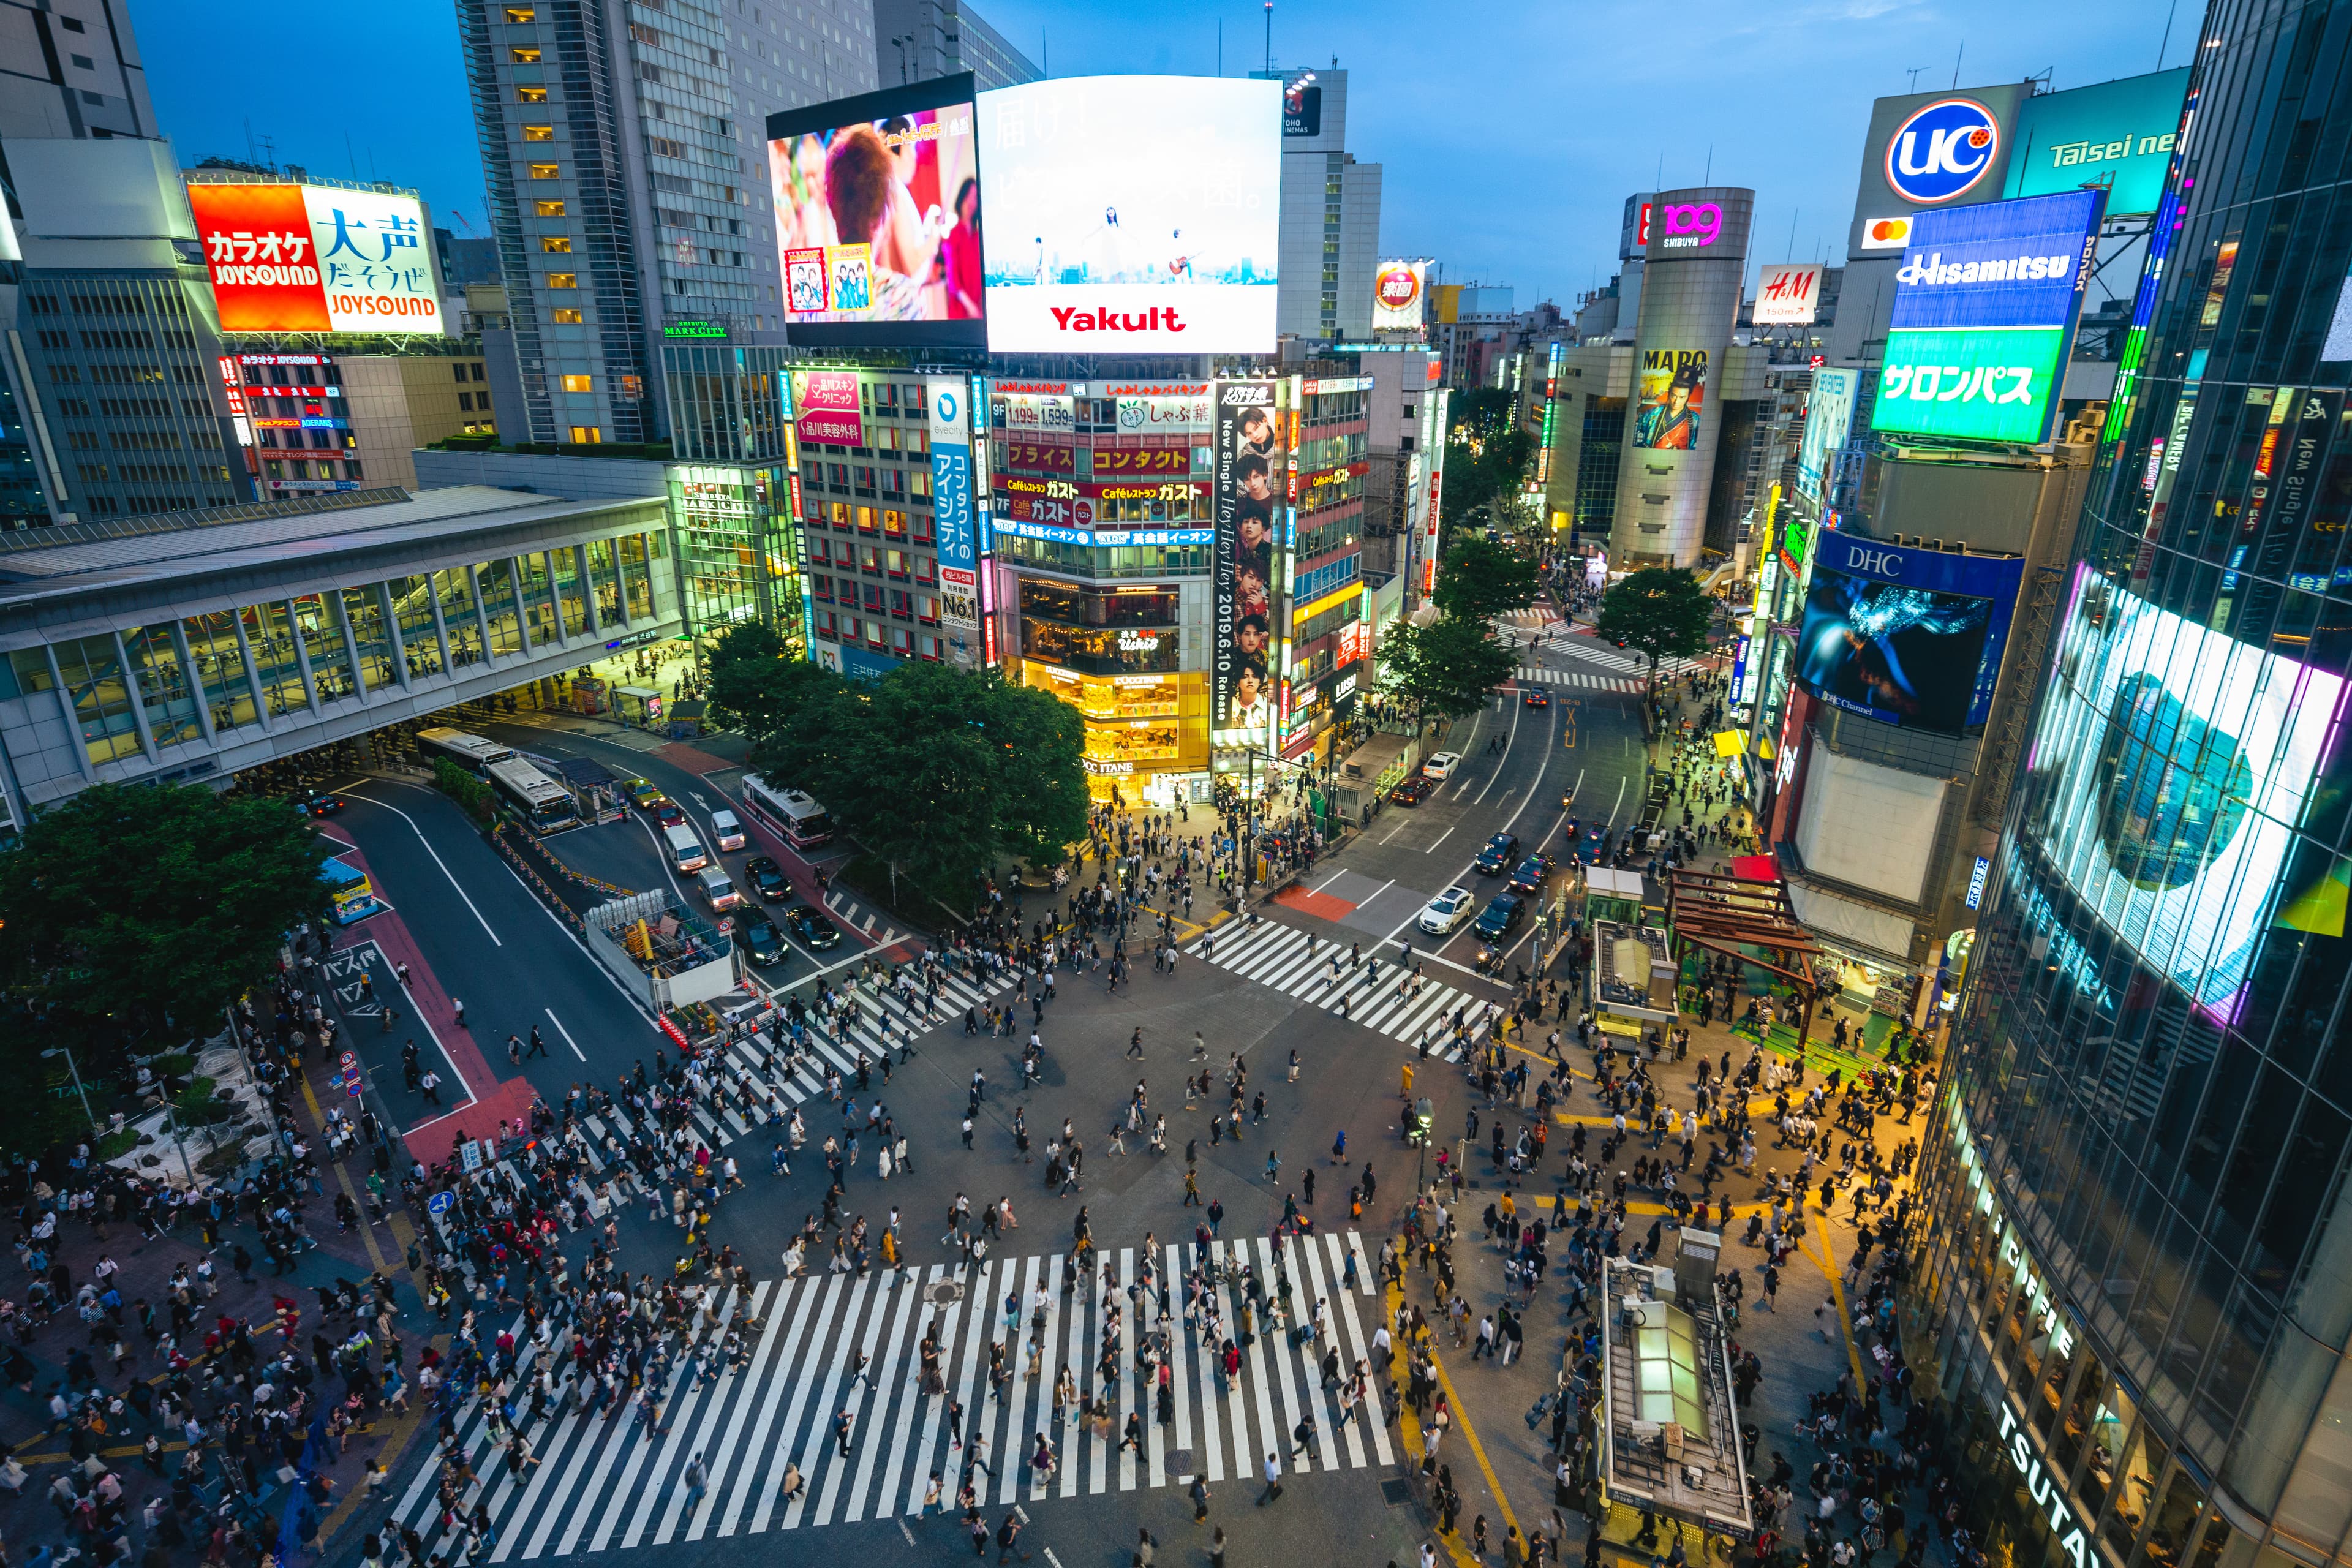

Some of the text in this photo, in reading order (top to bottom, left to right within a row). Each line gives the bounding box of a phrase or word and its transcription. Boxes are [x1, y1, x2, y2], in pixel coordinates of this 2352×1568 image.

[2050, 134, 2132, 168] Taisei
[317, 208, 419, 262] 大声
[1664, 203, 1722, 246] 109
[207, 231, 309, 263] カラオケ
[1664, 237, 1698, 247] SHIBUYA
[1896, 252, 2070, 286] Hisamitsu
[2073, 235, 2095, 292] サロンパス
[216, 264, 318, 285] JOYSOUND
[324, 262, 433, 295] だそうぜ。
[1382, 281, 1412, 297] 楽園
[1764, 271, 1815, 301] H&M
[333, 295, 435, 316] JOYSOUND
[1050, 306, 1186, 333] Yakult
[242, 355, 275, 364] カラオケ
[277, 355, 317, 364] JOYSOUND
[821, 379, 854, 391] 品川スキン
[995, 381, 1066, 394] しゃぶしゃぶバイキング
[1106, 384, 1208, 396] しゃぶしゃぶバイキング
[1883, 364, 2032, 405] サロンパス
[821, 393, 852, 404] クリニック
[993, 404, 1005, 416] 9F
[1151, 403, 1209, 423] しゃぶ葉
[301, 419, 333, 428] ADERANS
[806, 421, 859, 440] 品川美容外科
[934, 425, 963, 436] eyecity
[1221, 419, 1233, 448] New
[1010, 446, 1072, 467] プライス
[1094, 450, 1186, 469] コンタクト
[1219, 451, 1233, 492] Single
[1333, 468, 1350, 484] ガスト
[1047, 481, 1079, 500] ガスト
[1102, 484, 1202, 501] Caféレストラン ガスト
[936, 453, 955, 557] アイシティ
[954, 456, 970, 559] コンタクトの
[997, 497, 1009, 510] 7F
[1014, 500, 1030, 510] Café
[1031, 499, 1070, 522] ガスト
[1429, 497, 1439, 529] TaxFree
[1019, 524, 1075, 541] 英会話イーオン
[1133, 532, 1212, 544] 英会話イーオン
[1847, 546, 1903, 576] DHC
[946, 570, 972, 583] 当ビル5階
[941, 592, 977, 622] No.1
[943, 616, 977, 628] コンタクトショップ
[1218, 594, 1232, 671] 2019.6.10
[1738, 639, 1748, 663] MIZUHO
[1335, 674, 1357, 698] LUSH
[1218, 677, 1228, 721] Release
[1841, 699, 1873, 716] Channel
